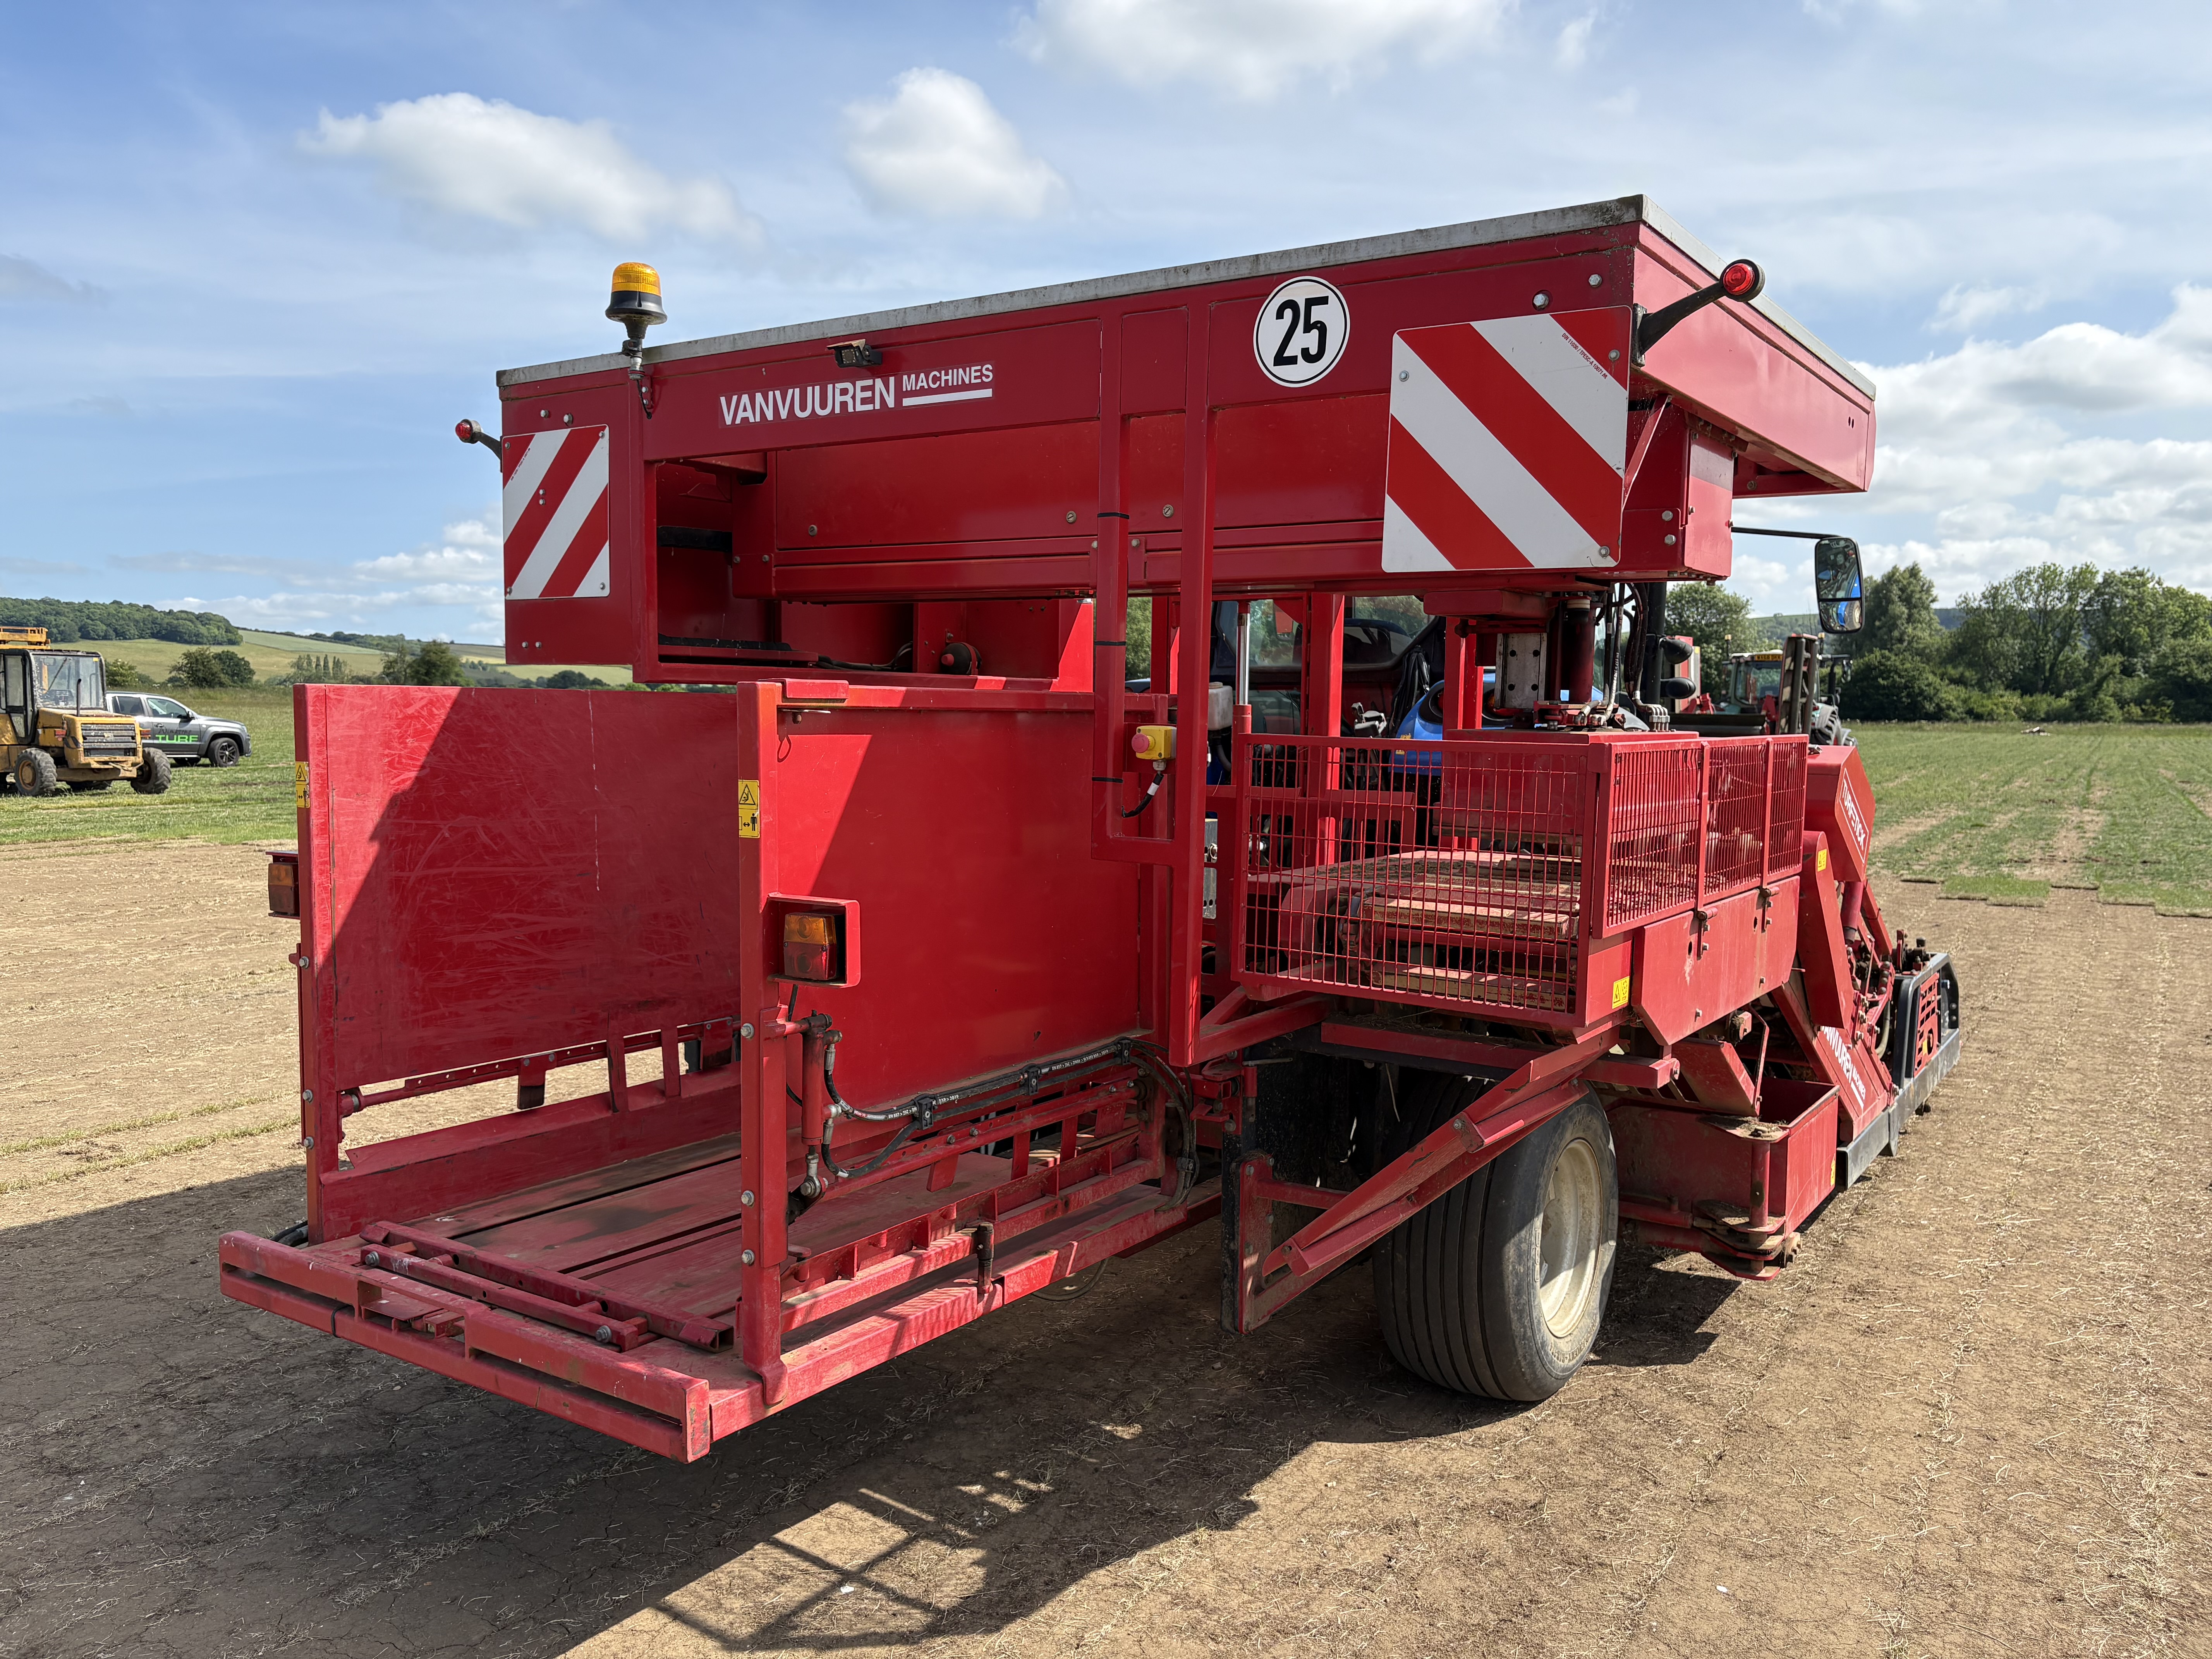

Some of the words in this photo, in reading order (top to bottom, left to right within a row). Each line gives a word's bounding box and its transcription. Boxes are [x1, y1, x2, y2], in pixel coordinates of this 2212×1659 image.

[1273, 295, 1329, 366] 25
[1568, 339, 1579, 350] 11030
[720, 376, 895, 425] VANVUUREN
[902, 364, 993, 391] MACHINES
[155, 735, 199, 743] TURF
[1842, 778, 1866, 851] TURF-TICK
[1820, 1026, 1853, 1084] ANVUUREN
